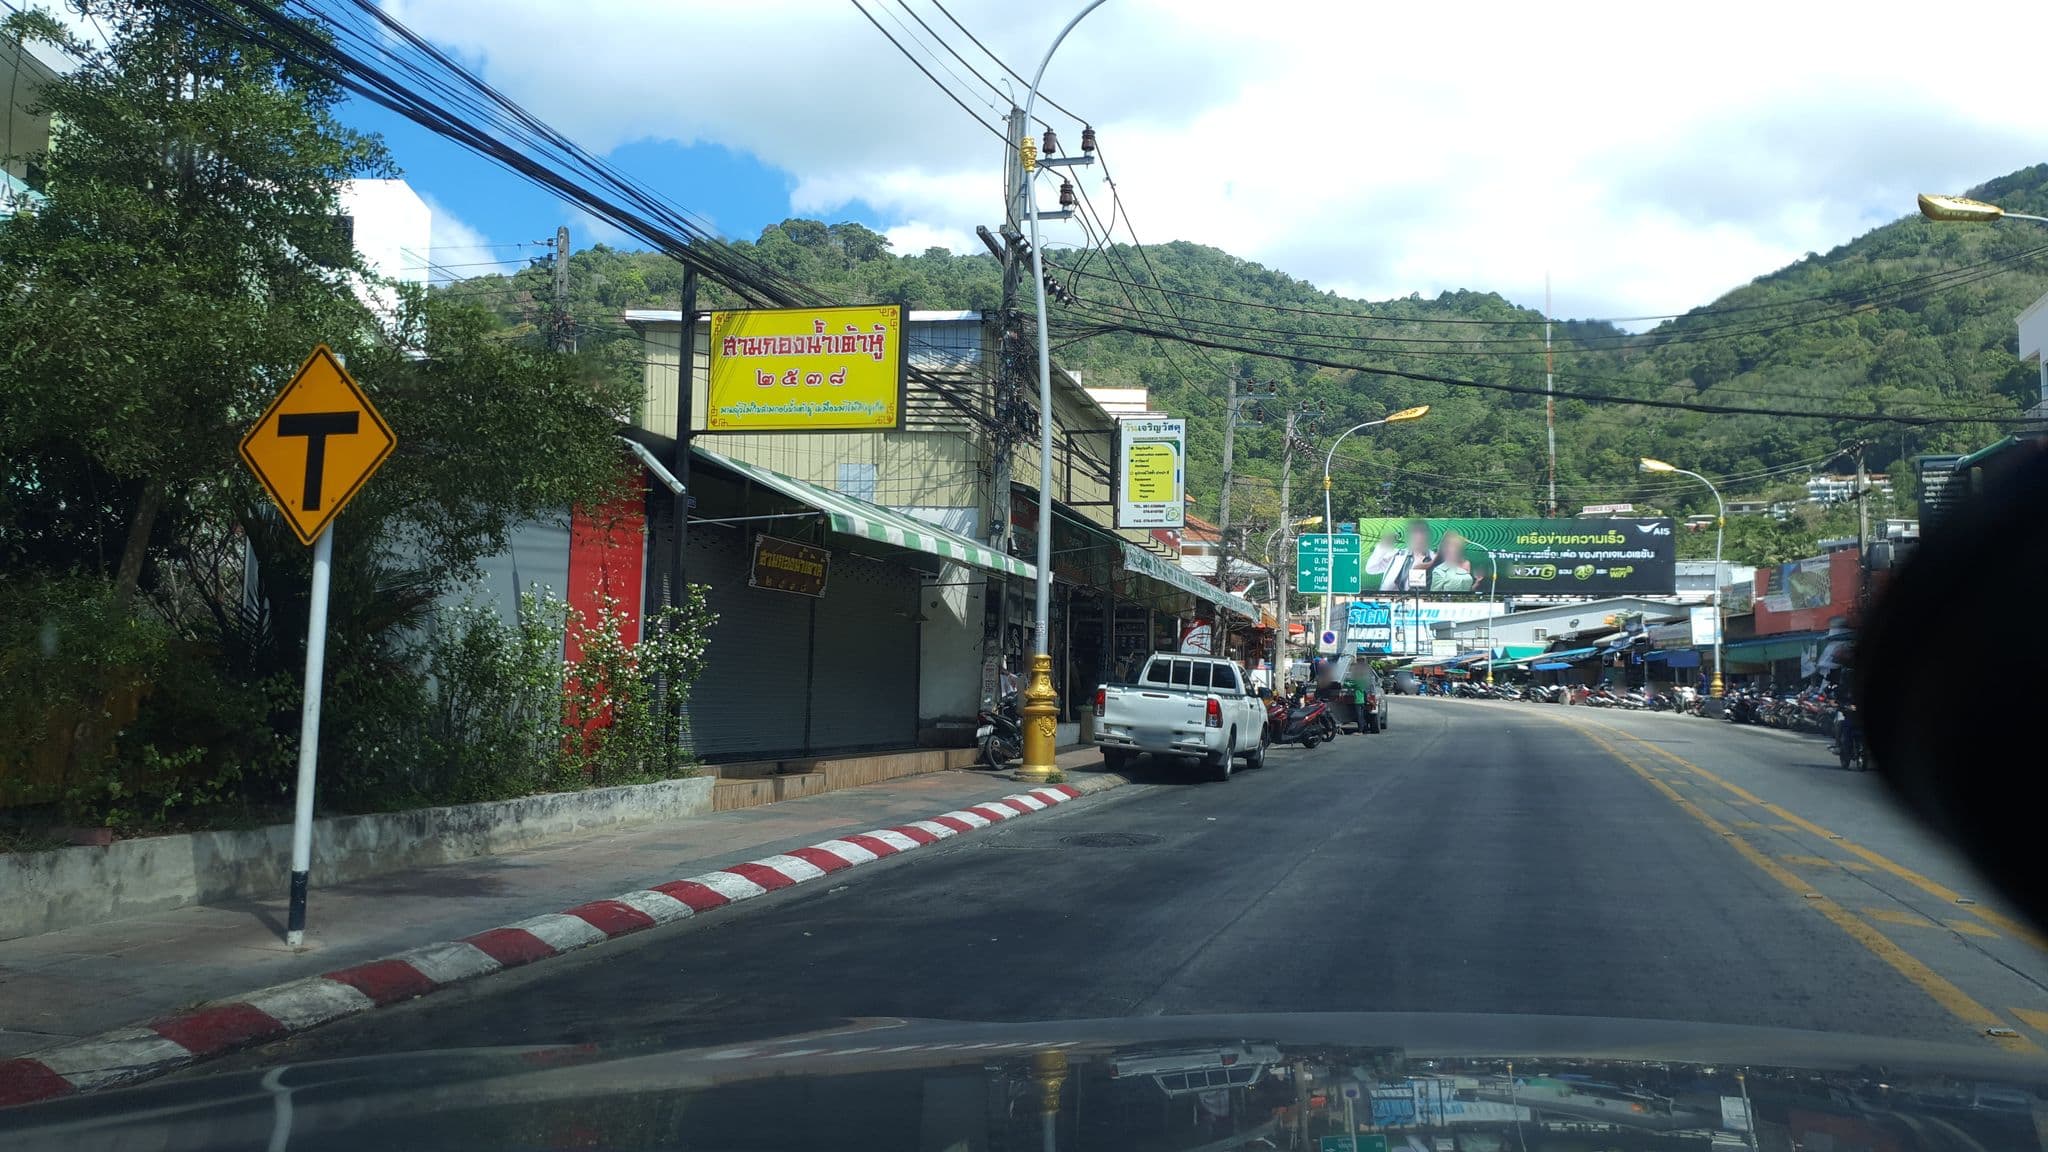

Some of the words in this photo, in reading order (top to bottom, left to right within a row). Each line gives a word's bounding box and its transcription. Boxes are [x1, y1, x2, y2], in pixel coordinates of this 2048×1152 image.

[722, 319, 887, 361] สามกองน้ำเต้าหู้
[1516, 530, 1626, 545] เครือข่ายความเร็ว
[1653, 527, 1671, 536] AIS
[1349, 576, 1358, 584] 10
[1348, 608, 1389, 625] SIGN
